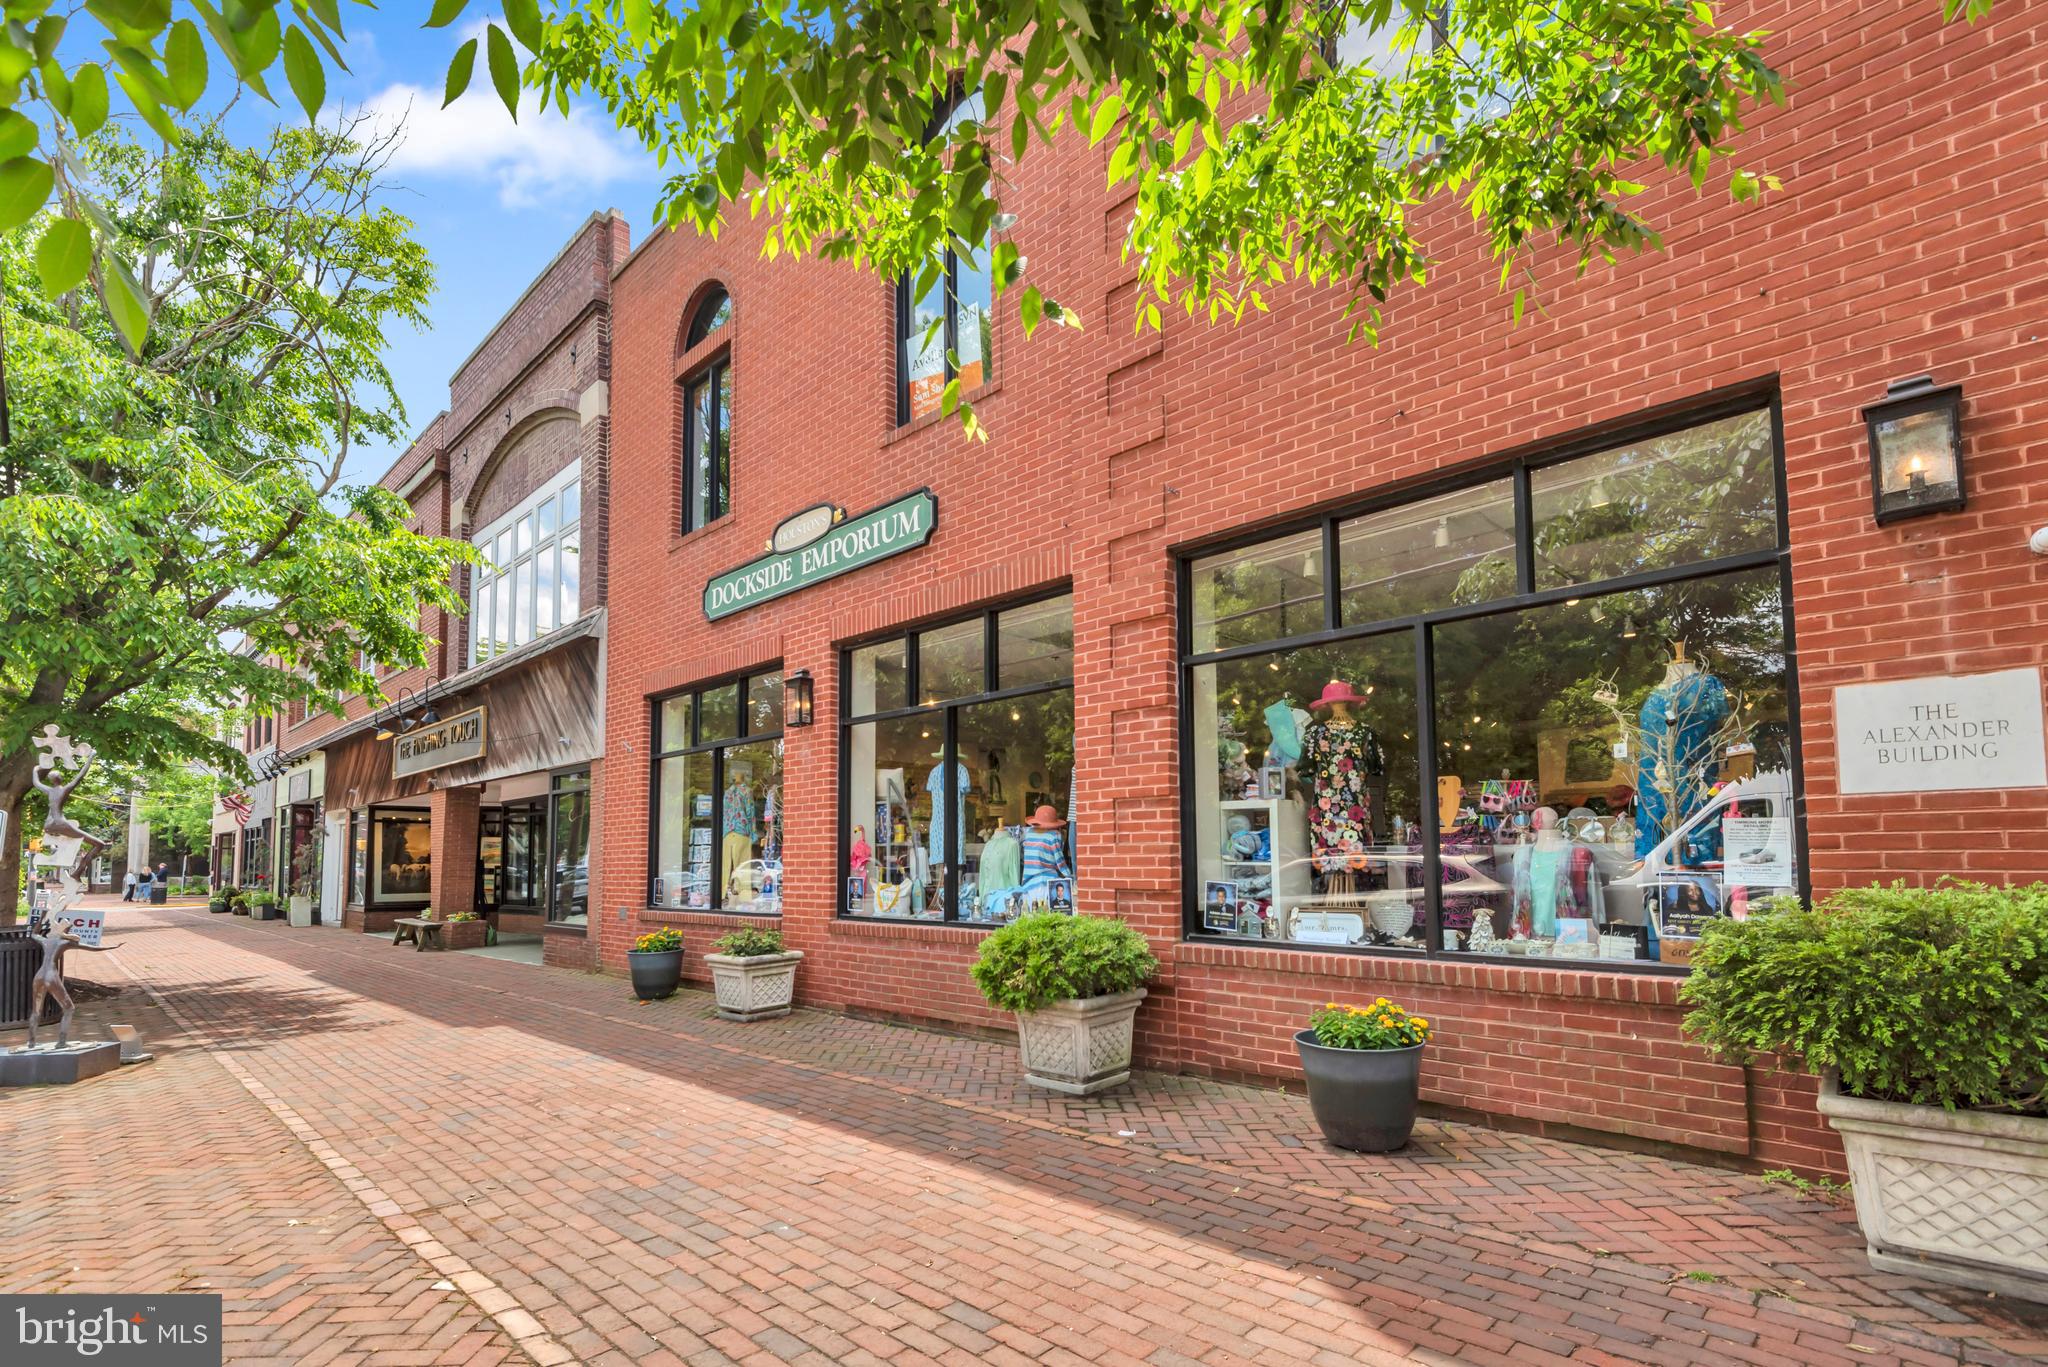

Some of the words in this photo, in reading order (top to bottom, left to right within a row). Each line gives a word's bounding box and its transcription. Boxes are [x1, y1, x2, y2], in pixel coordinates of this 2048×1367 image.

[958, 307, 977, 325] SVN
[711, 558, 793, 610] DOCKSIDE
[801, 505, 920, 576] EMPORIUM
[1909, 703, 1959, 721] THE
[400, 741, 411, 760] THE
[413, 728, 447, 756] FINISHING
[450, 717, 478, 744] TOUCH
[1862, 719, 2013, 745] ALEXANDER
[1878, 742, 1999, 764] BUILDING
